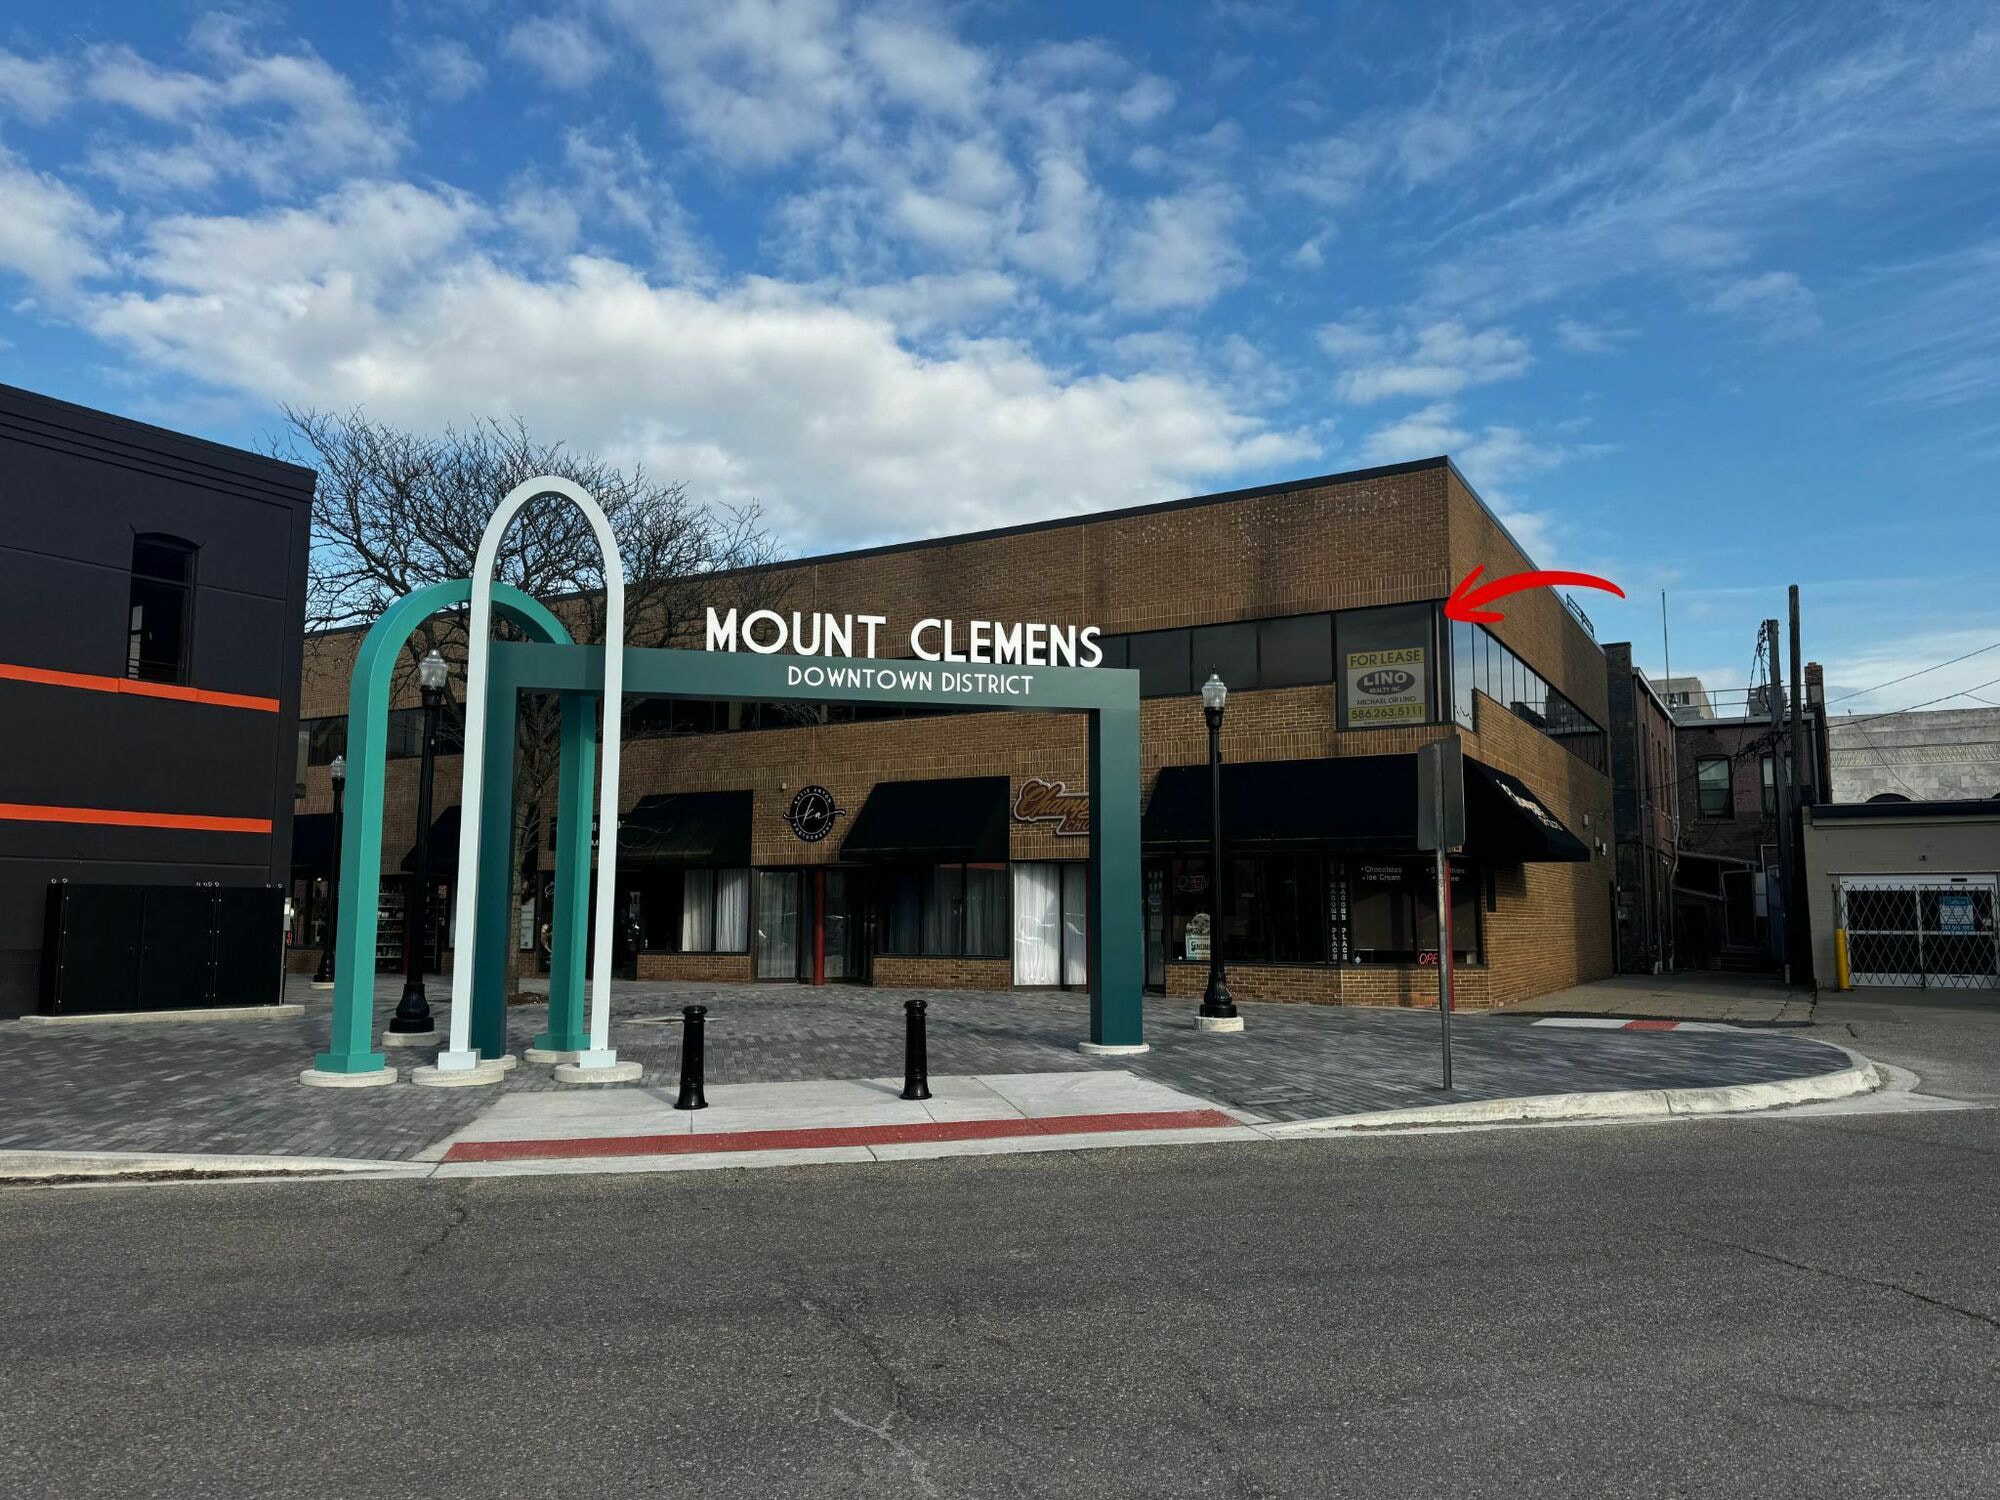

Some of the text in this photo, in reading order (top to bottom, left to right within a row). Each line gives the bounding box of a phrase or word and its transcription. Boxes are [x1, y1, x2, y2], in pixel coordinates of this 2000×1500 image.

[706, 606, 1103, 668] MOUNT CLEMENS
[1350, 650, 1420, 667] FOR LEASE
[788, 665, 1034, 695] DOWNTOWN DISTRICT
[1363, 672, 1407, 686] LINO
[1020, 781, 1089, 819] Champ
[1364, 865, 1402, 873] Chocolates
[1419, 952, 1438, 964] OPE
